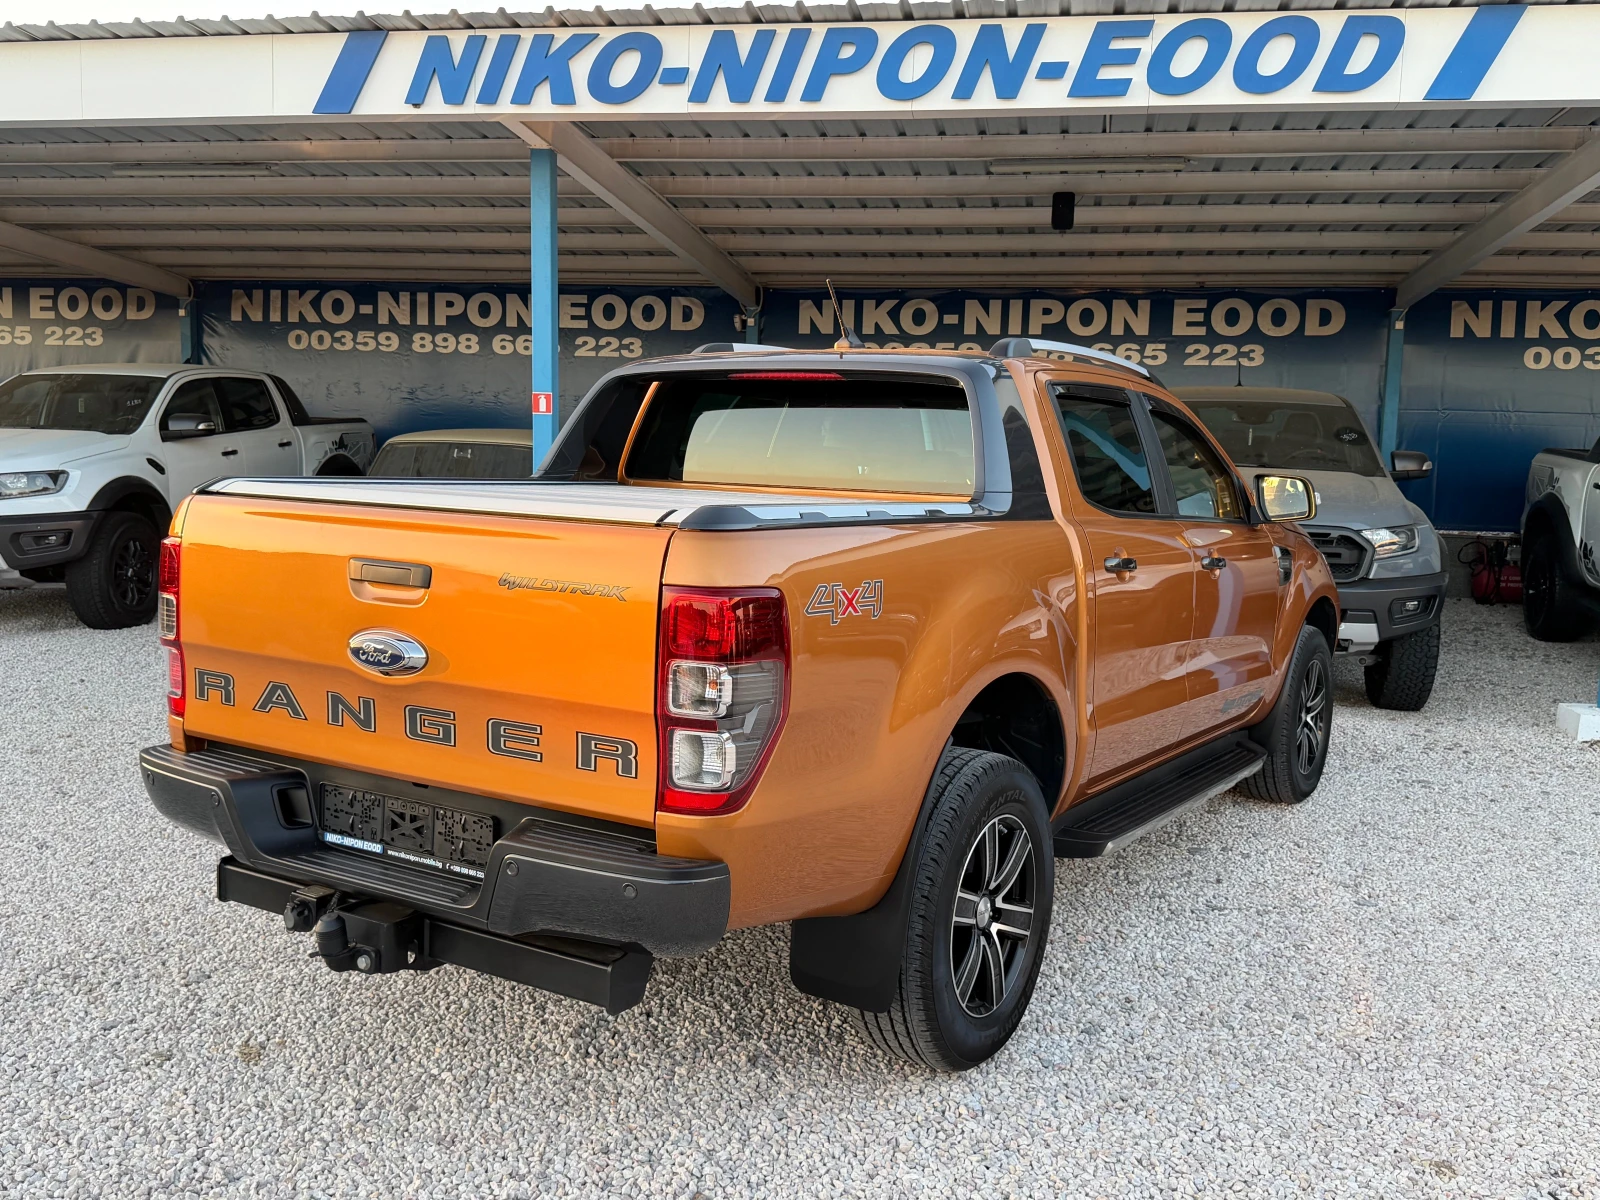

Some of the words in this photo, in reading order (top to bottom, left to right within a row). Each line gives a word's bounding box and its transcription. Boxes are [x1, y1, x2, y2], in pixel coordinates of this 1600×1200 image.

[403, 15, 1406, 106] NIKO-NIPON-EOOD
[29, 286, 156, 321] EOOD
[230, 288, 532, 328] NIKO-NIPON
[558, 293, 705, 331] EOOD
[798, 298, 1151, 337] NIKO-NIPON
[1171, 297, 1346, 337] EOOD
[1450, 299, 1600, 340] NIKO
[44, 326, 104, 347] 223
[287, 329, 400, 352] 00359
[411, 332, 480, 354] 898
[491, 334, 561, 356] 66
[574, 336, 643, 358] 223
[1183, 343, 1265, 367] 223
[1523, 346, 1600, 370] 003
[498, 572, 631, 602] WILDTRAK
[359, 641, 393, 664] Ford
[194, 667, 638, 779] RANGER
[326, 832, 363, 849] NIKO-NIPON
[363, 841, 381, 853] EOOD
